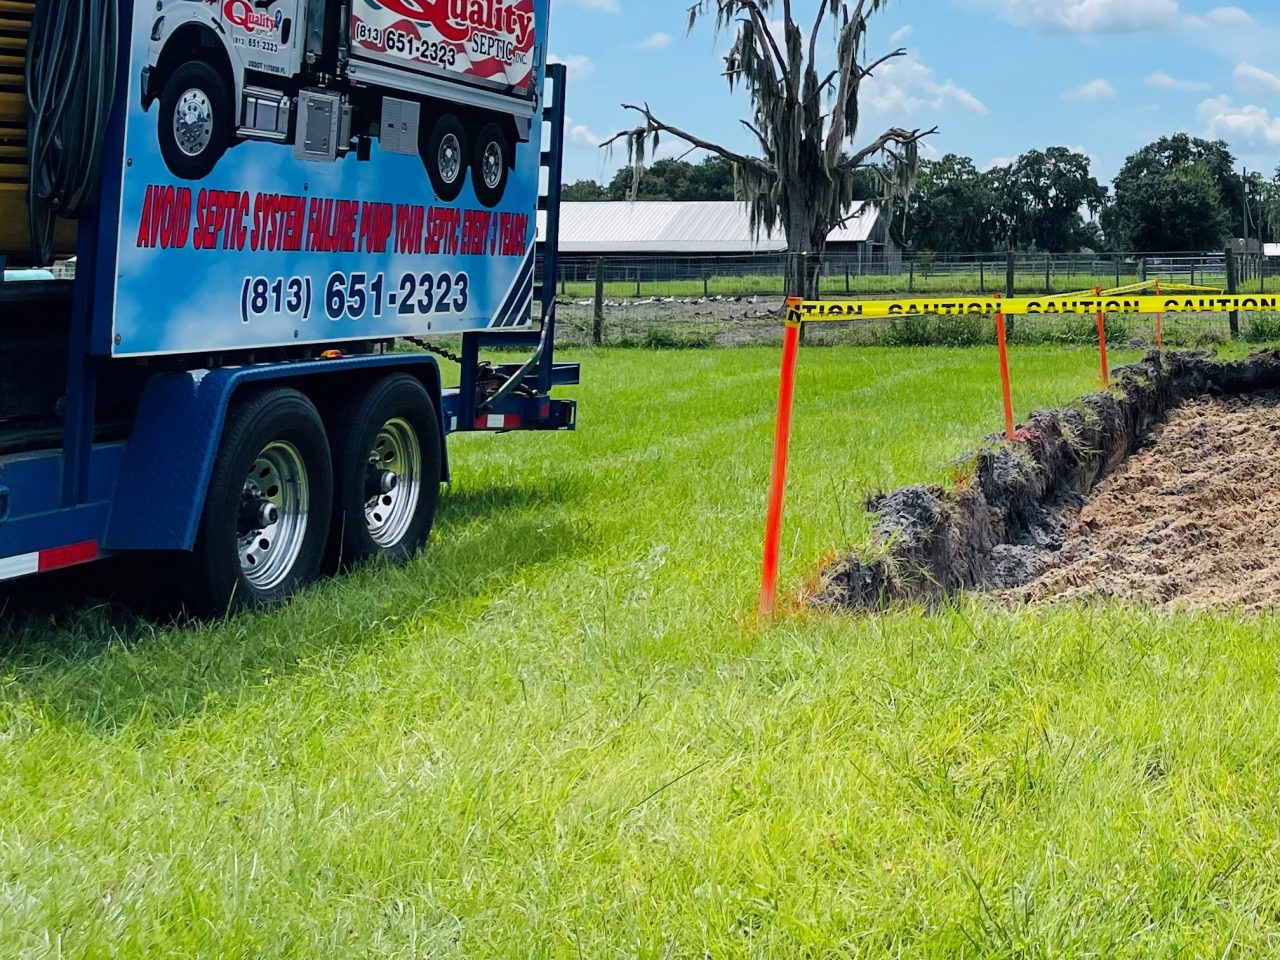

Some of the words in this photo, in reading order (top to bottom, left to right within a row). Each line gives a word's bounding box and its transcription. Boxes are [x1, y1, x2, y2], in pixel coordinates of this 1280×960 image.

[224, 0, 277, 33] Quality
[248, 38, 278, 52] 651-2323
[356, 22, 382, 45] (813)
[386, 31, 456, 66] 651-2323
[137, 184, 191, 249] AVOID
[193, 187, 250, 251] SEPTIC
[250, 192, 306, 251] SYSTEM
[305, 197, 359, 253] FAILURE
[358, 201, 393, 253] PUMP
[394, 204, 424, 254] YOUR
[424, 205, 460, 256] SEPTIC
[460, 208, 492, 255] EVERY
[489, 211, 498, 256] 3
[498, 212, 529, 257] YEARS!
[241, 277, 311, 322] (813)
[325, 272, 469, 320] 651-2323
[888, 302, 1001, 315] CAUTION
[1027, 300, 1139, 313] CAUTION
[1164, 298, 1276, 312] CAUTION
